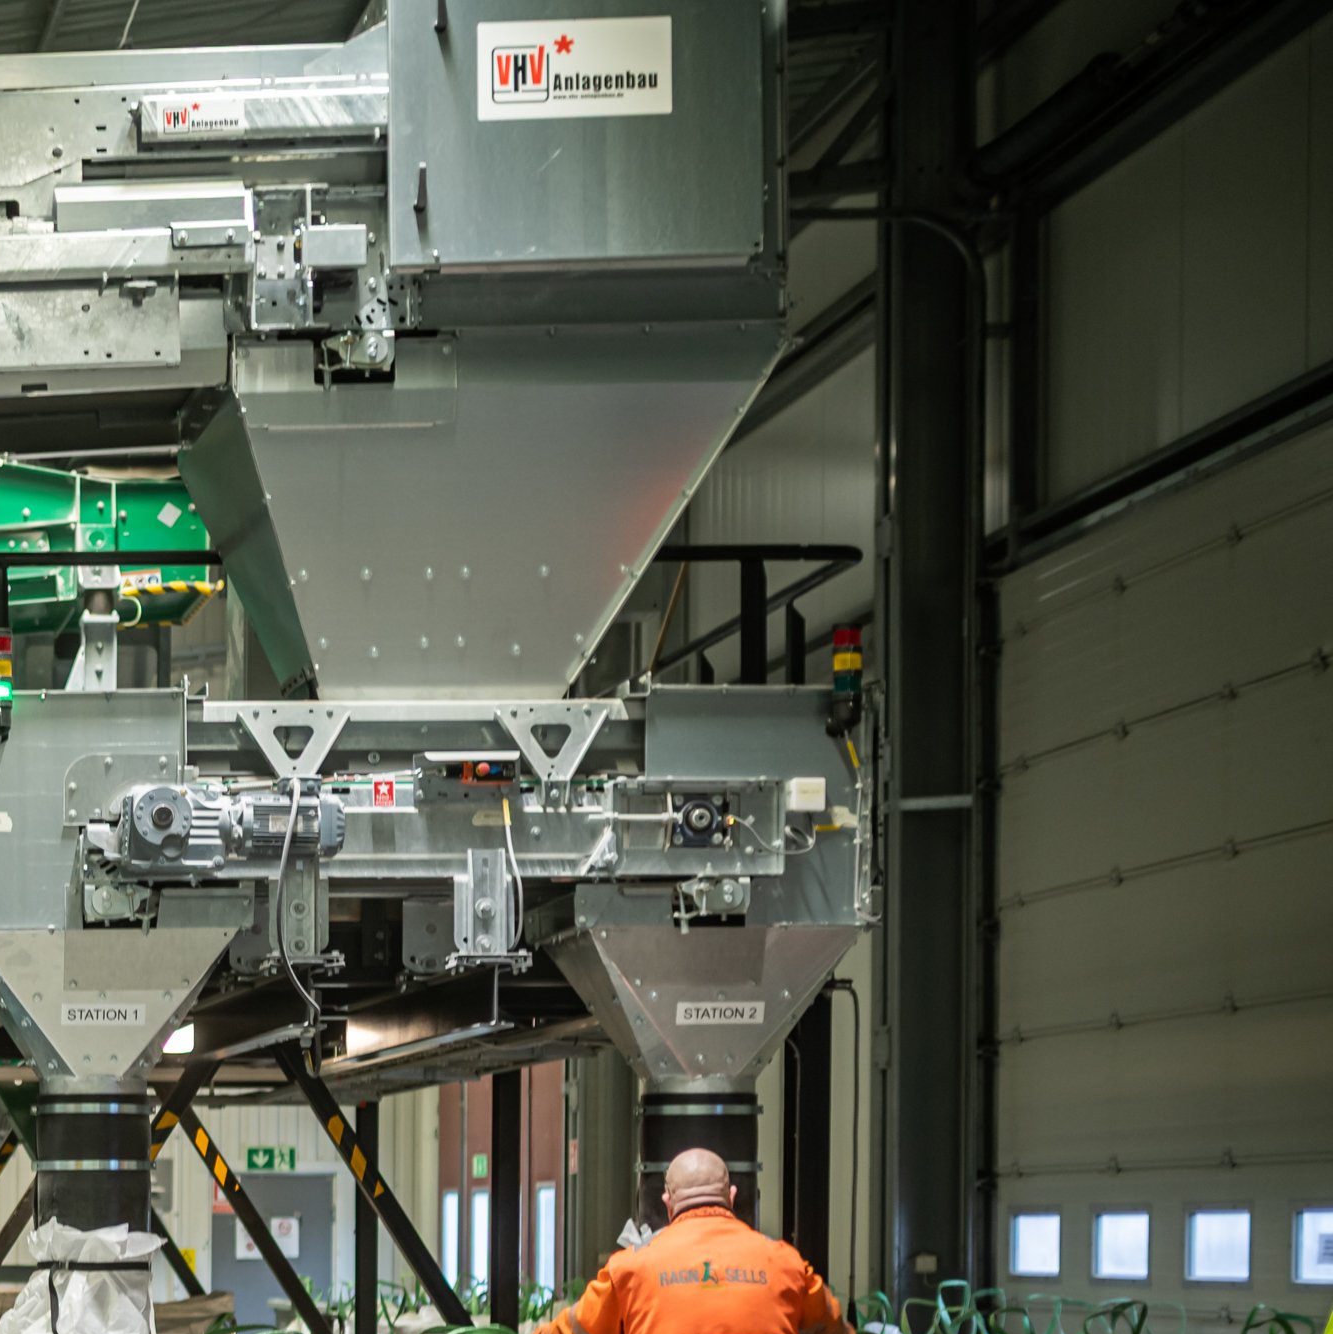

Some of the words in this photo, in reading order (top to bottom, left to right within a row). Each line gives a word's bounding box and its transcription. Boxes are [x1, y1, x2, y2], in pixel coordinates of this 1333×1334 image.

[496, 45, 545, 92] VHV
[552, 70, 658, 92] Anlagenbau
[165, 107, 187, 129] VHV
[191, 118, 239, 129] Anlagenbau
[67, 1008, 127, 1021] STATION
[132, 1008, 138, 1021] 1
[683, 1007, 745, 1020] STATION
[748, 1007, 757, 1019] 2
[659, 1268, 700, 1286] RAGN
[724, 1266, 768, 1285] SELLS
